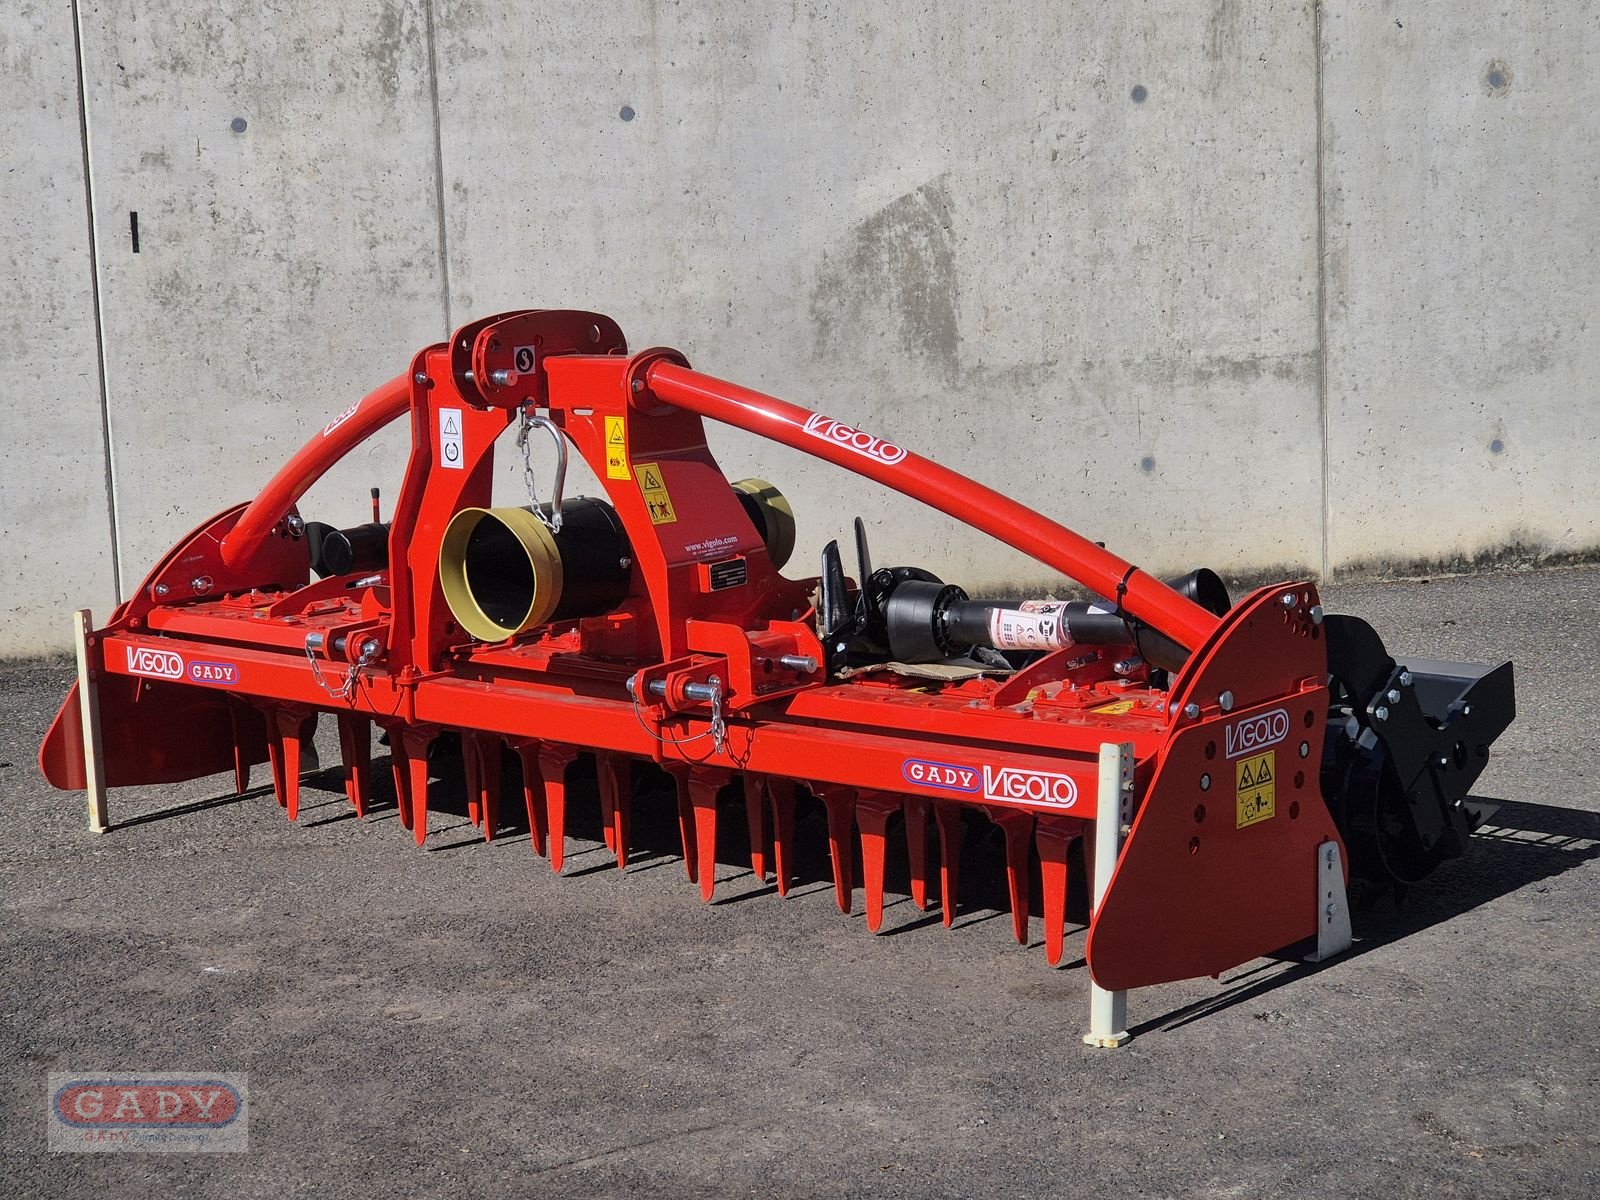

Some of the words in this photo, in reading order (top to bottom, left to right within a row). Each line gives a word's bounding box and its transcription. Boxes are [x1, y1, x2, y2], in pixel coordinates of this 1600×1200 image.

[803, 413, 905, 463] VIGOLO
[685, 536, 738, 552] www.vigolo.com
[127, 646, 183, 678] VIGOLO
[192, 665, 233, 680] GADY
[1226, 709, 1288, 758] VIGOLO
[911, 764, 973, 787] GADY
[983, 765, 1076, 807] VIGOLO
